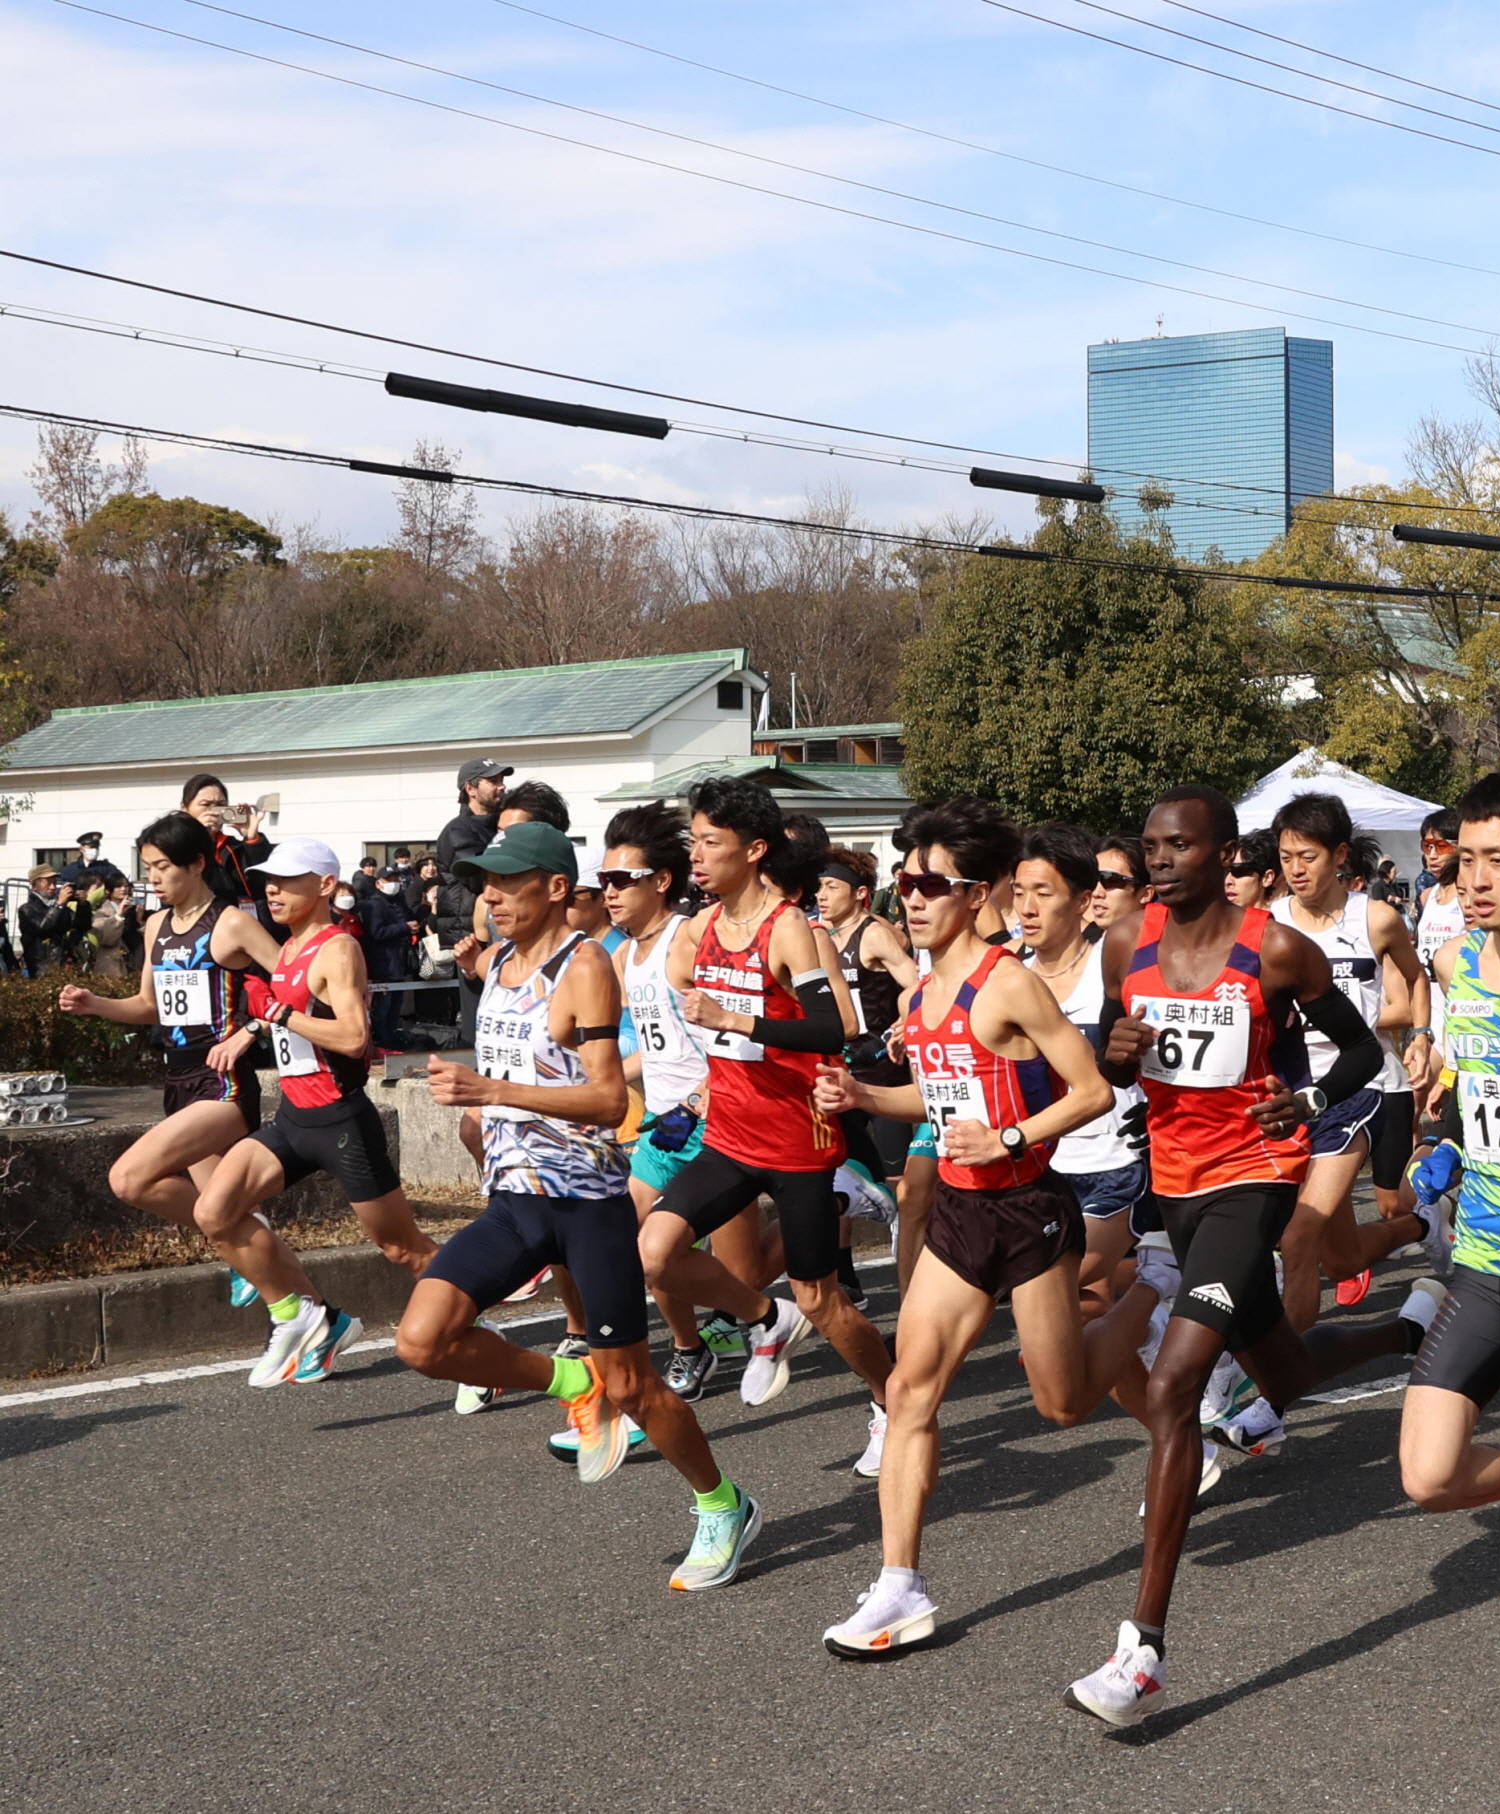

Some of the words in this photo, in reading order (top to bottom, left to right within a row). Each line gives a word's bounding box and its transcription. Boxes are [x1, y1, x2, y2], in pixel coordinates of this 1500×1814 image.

[164, 972, 199, 987] 奥村組
[694, 964, 764, 991] トヨタ紡織
[162, 989, 189, 1016] 98
[634, 1004, 661, 1020] 奥村組
[1459, 1004, 1491, 1014] SOMPO
[1164, 1003, 1235, 1026] 奥村組
[640, 1022, 666, 1052] 15
[482, 1045, 523, 1067] 奥村組
[1157, 1027, 1215, 1071] 67
[925, 1082, 970, 1101] 奥村組
